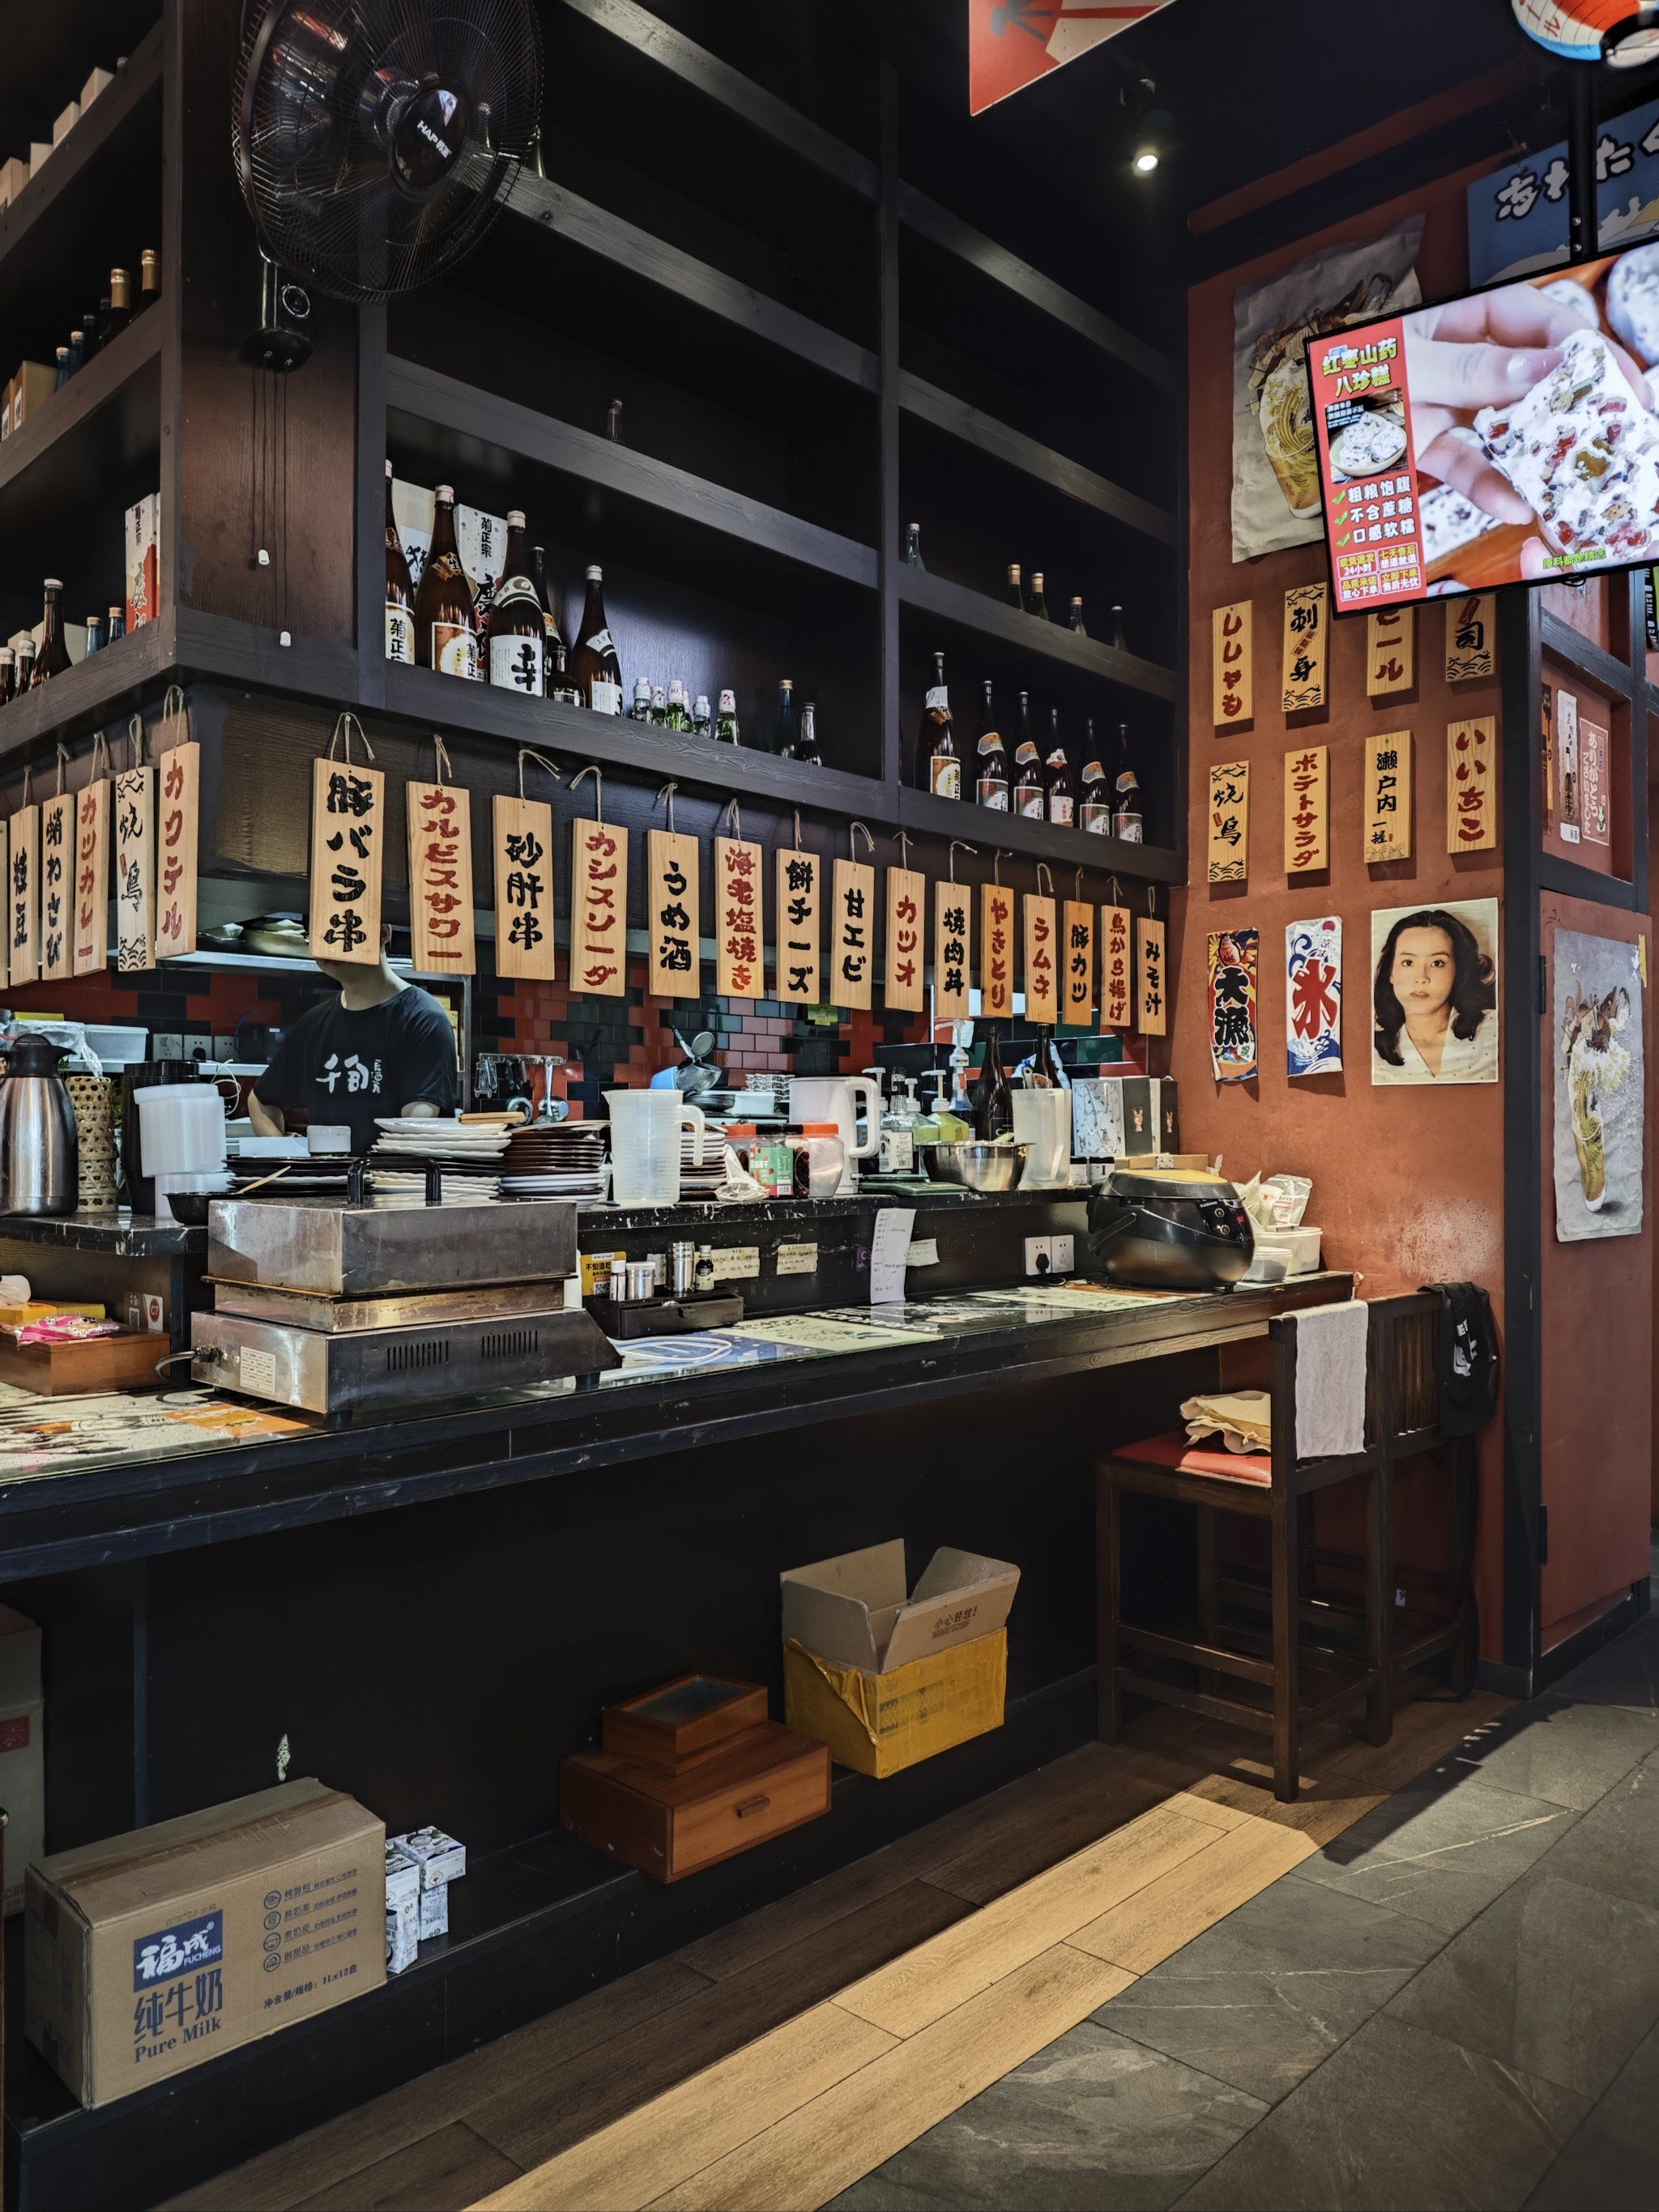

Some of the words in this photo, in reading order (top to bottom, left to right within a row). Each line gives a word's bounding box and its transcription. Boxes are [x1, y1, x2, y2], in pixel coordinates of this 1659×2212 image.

[1323, 338, 1397, 377] 红枣山药
[1335, 364, 1391, 398] 八珍糕
[1348, 475, 1411, 503] 粗粮饱腹
[1350, 497, 1413, 523] 不含蔗糖
[1340, 553, 1375, 568] 现货速发
[1344, 563, 1371, 576] 24小时
[1353, 518, 1415, 543] 口感软糯
[1380, 545, 1416, 558] 七天售后
[1222, 613, 1243, 717] ししゃも
[1290, 603, 1319, 682] 刺身
[1291, 753, 1320, 867] ポテトサラダ
[1456, 729, 1486, 842] いいちこ
[46, 807, 63, 969] 蛸わさび
[79, 794, 96, 957] カツカレー
[162, 759, 184, 940] カクテル
[324, 771, 374, 953] 豚バラ串
[505, 832, 544, 950] 砂肝串
[583, 831, 617, 987] カシスソーダ
[660, 861, 691, 972] うめ酒
[842, 888, 866, 982] 甘エビ
[895, 895, 918, 987] カツオ
[991, 897, 1009, 1009] やきとり
[1033, 918, 1051, 1000] ラムネ
[1071, 923, 1090, 1003] 豚カツ
[1109, 913, 1126, 1021] 鳥から揚げ
[1145, 940, 1162, 1016] みそ汁
[1214, 966, 1250, 1046] 大漁
[1292, 958, 1338, 1041] 氷
[151, 1305, 159, 1315] C7
[136, 1929, 209, 1980] 福成
[184, 1945, 221, 1967] FUCHENG
[134, 1967, 223, 2044] 纯牛奶
[134, 2036, 177, 2063] Pure
[182, 2017, 222, 2044] Milk
